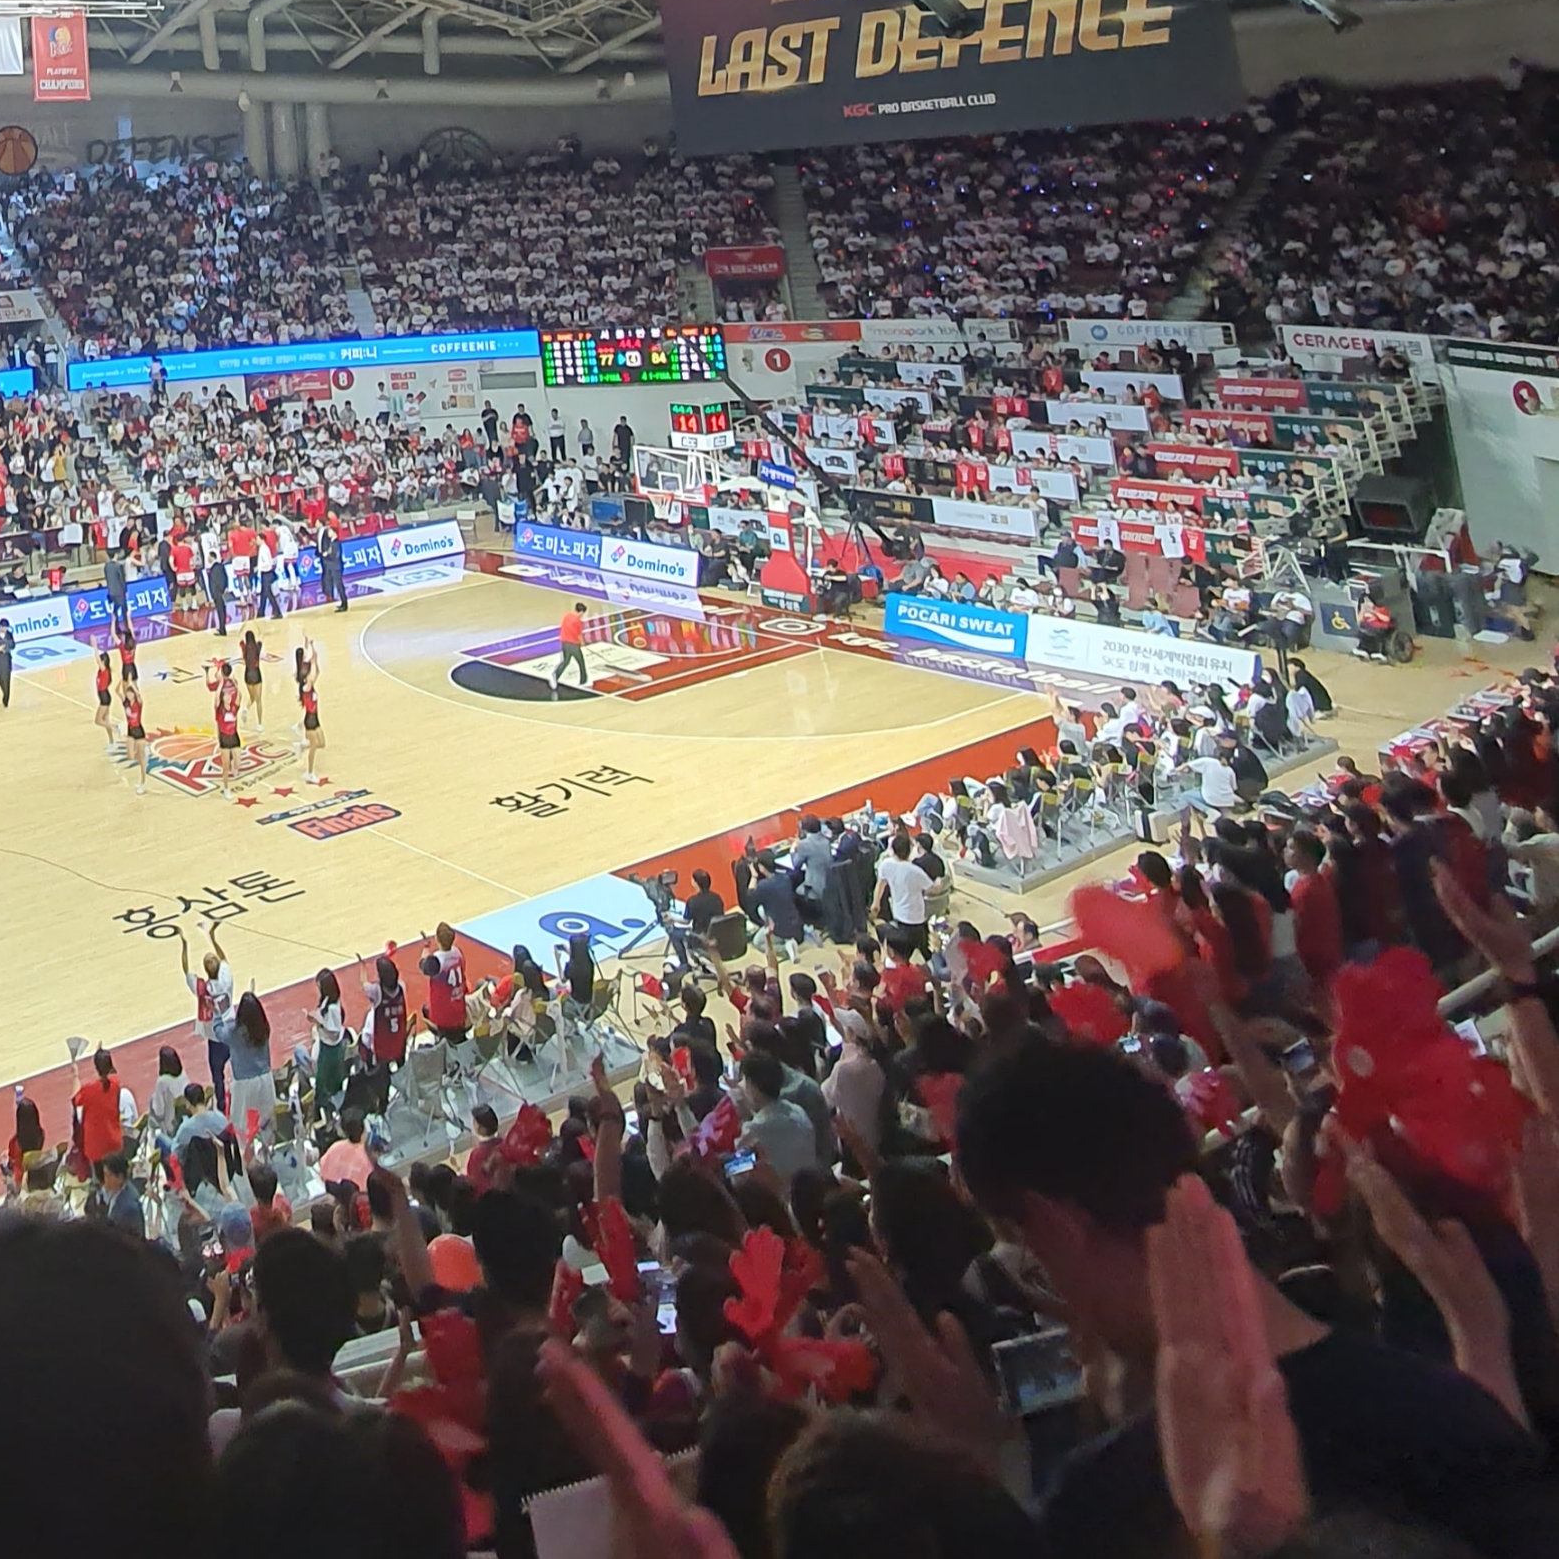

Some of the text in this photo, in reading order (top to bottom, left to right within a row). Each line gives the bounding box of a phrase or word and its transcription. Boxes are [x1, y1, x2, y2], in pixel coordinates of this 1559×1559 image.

[697, 15, 841, 98] LAST
[843, 93, 997, 118] KGC PRO BASKETBALL CLUB
[1117, 323, 1199, 339] COFFEENIE
[431, 340, 497, 355] COFFEENIE
[1292, 332, 1375, 351] CERAGEM
[599, 352, 668, 367] 77 84
[772, 353, 782, 368] 1
[679, 413, 726, 432] 14 14
[405, 535, 455, 556] Domino's
[531, 532, 685, 578] 도미노피자 Domino's
[897, 604, 956, 628] POCARI
[959, 616, 1015, 636] SWEAT
[1103, 640, 1130, 654] 2030
[488, 764, 656, 818] 활기력
[289, 803, 399, 838] Finals
[111, 871, 303, 939] 홍삼톤
[447, 966, 463, 986] 41
[389, 1018, 399, 1033] 5
